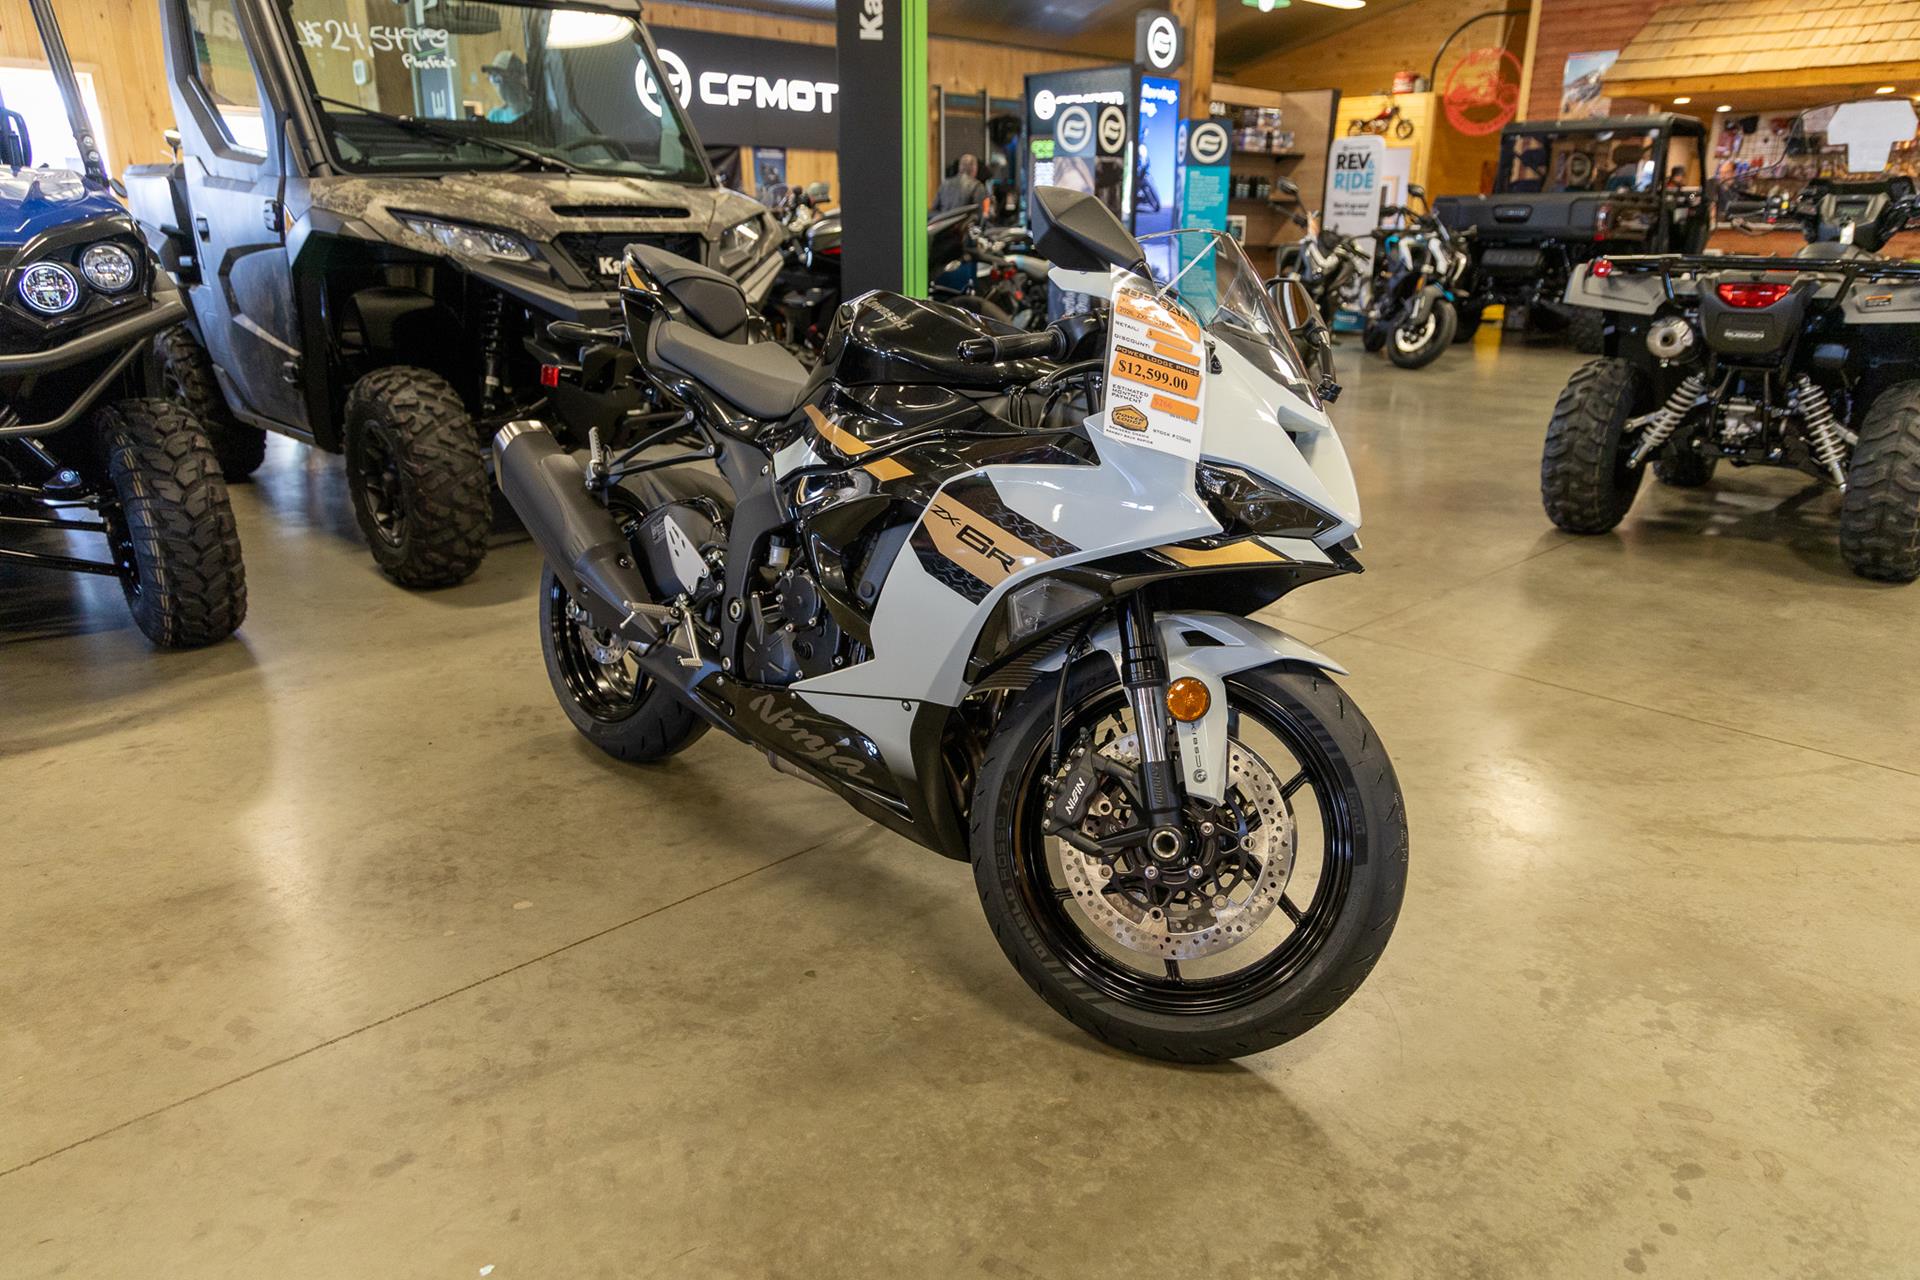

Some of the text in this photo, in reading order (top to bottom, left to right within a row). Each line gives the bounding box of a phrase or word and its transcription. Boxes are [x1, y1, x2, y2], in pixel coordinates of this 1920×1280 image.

[1335, 152, 1371, 170] REV
[1334, 172, 1375, 192] RIDE
[1116, 346, 1199, 376] POWER LODGE PRICE
[1118, 359, 1188, 391] $12,599.00
[1111, 392, 1142, 404] PAYMENT
[1112, 383, 1149, 398] ESTIMATED
[1112, 388, 1143, 400] MONTHLY
[1115, 412, 1144, 423] POWER
[749, 694, 875, 784] Ninja
[1064, 776, 1087, 816] NISSIN
